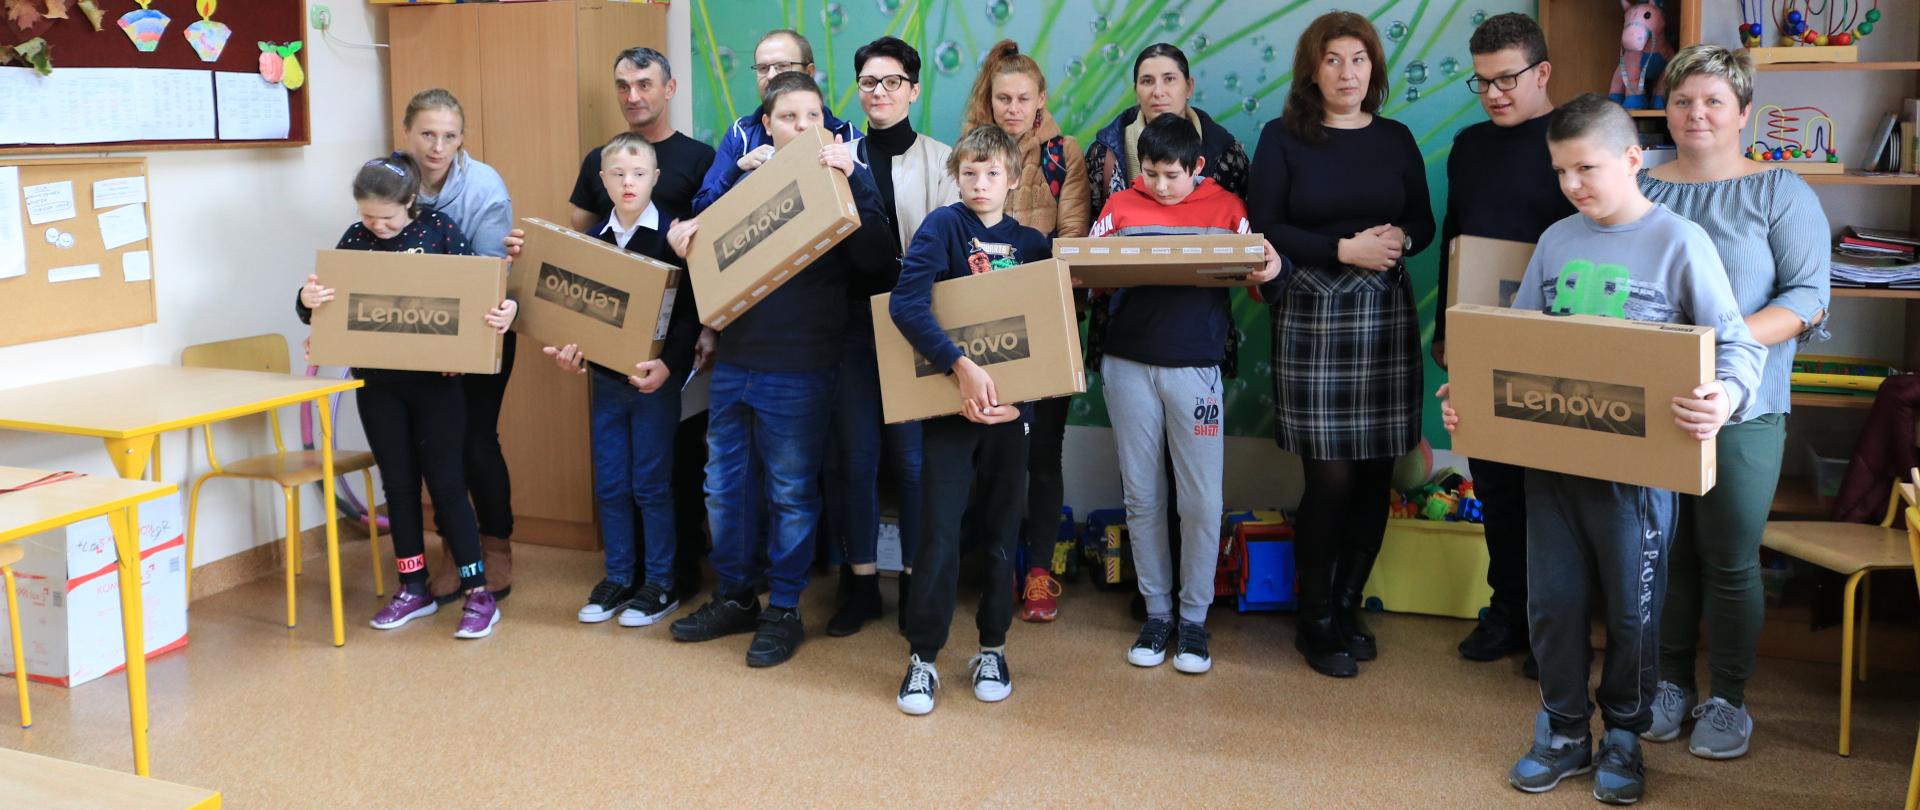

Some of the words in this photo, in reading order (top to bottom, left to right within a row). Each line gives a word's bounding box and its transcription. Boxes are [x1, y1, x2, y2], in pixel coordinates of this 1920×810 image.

[722, 198, 794, 259] Lenovo
[545, 274, 620, 318] Lenovo
[357, 302, 450, 326] Lenovo
[957, 332, 1018, 357] novo
[1506, 382, 1632, 422] Lenovo
[397, 556, 424, 571] OOK
